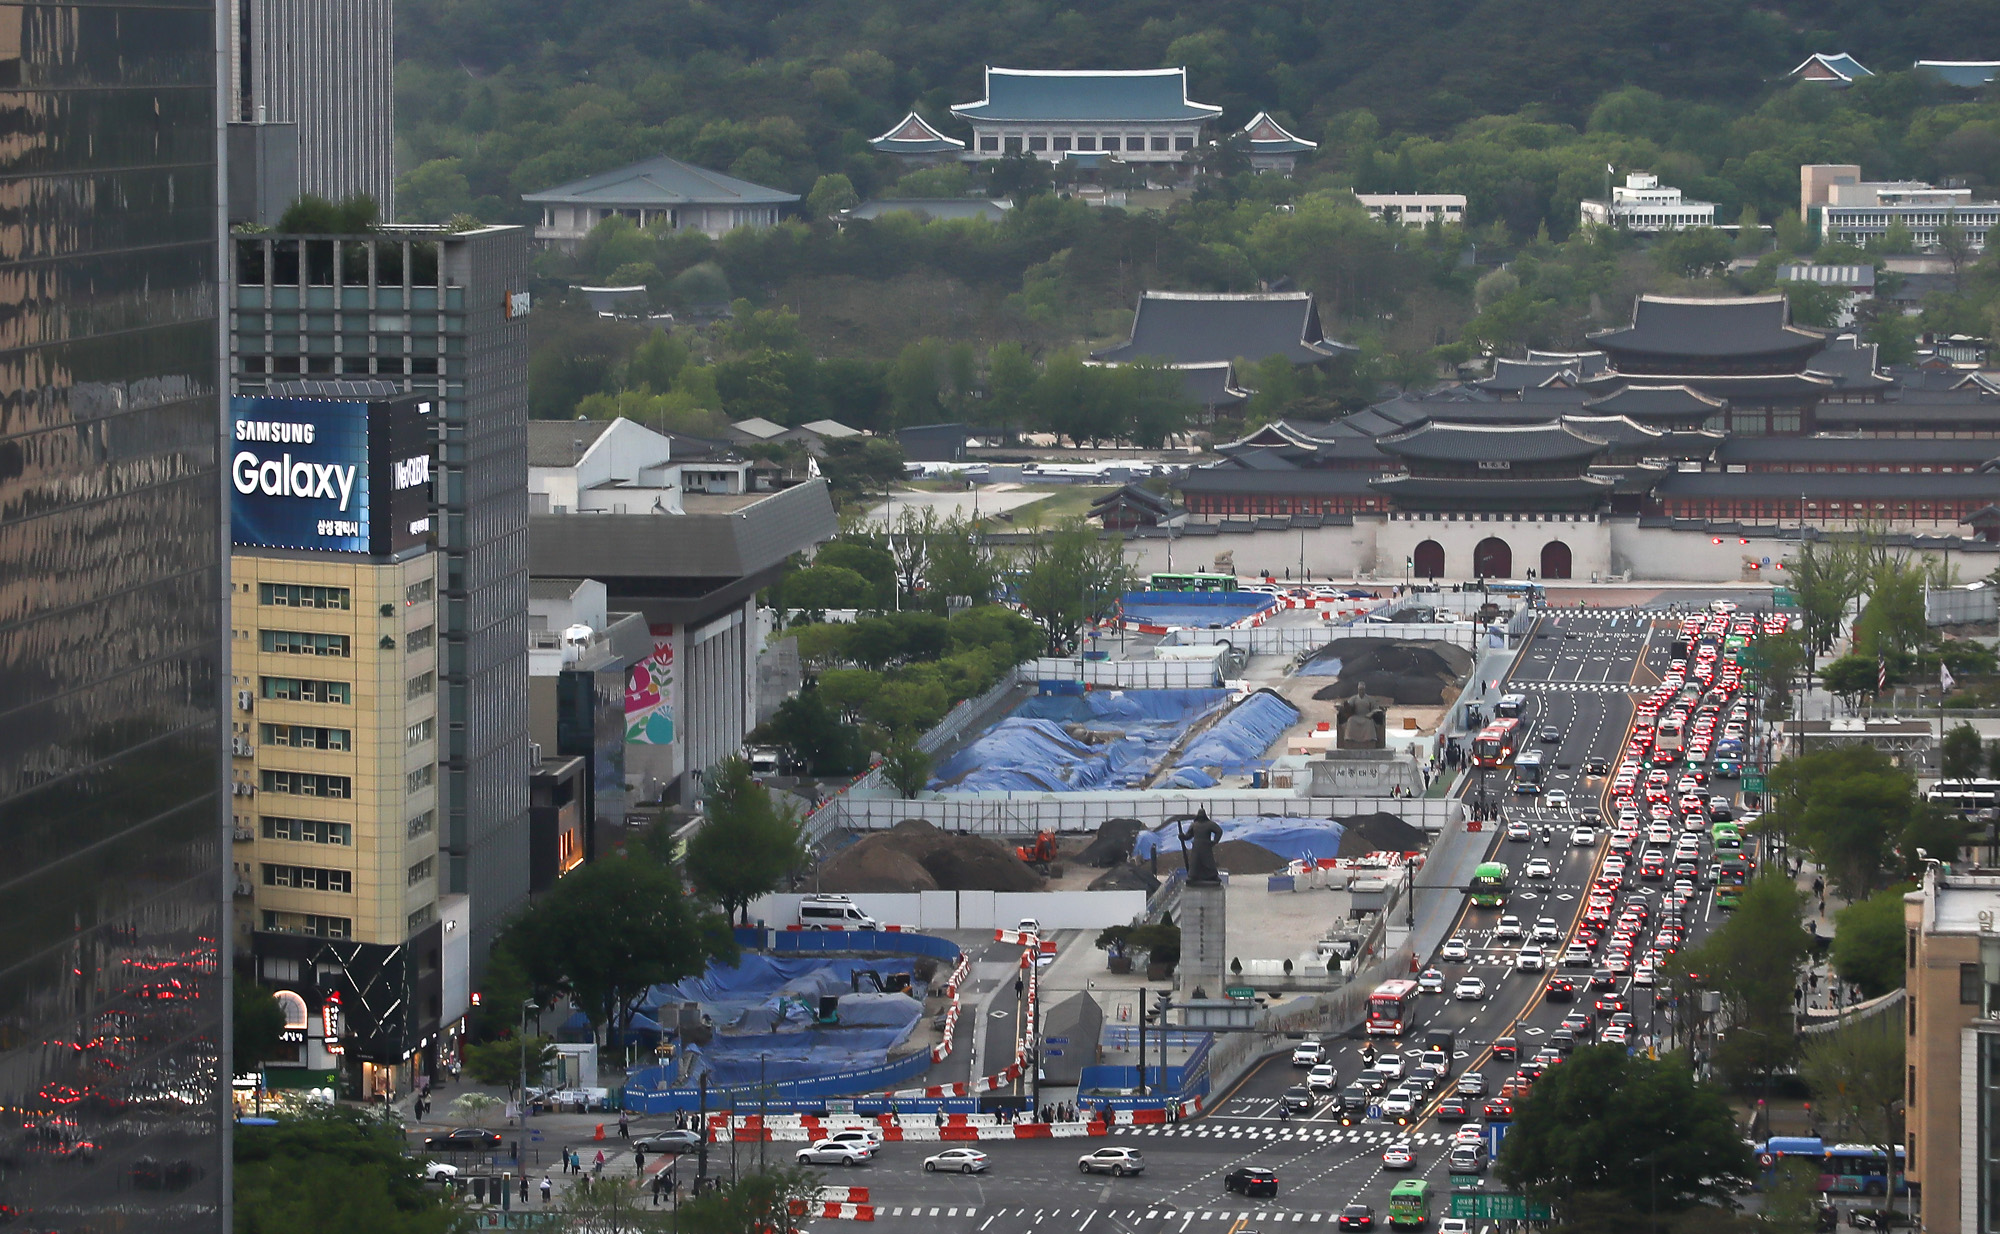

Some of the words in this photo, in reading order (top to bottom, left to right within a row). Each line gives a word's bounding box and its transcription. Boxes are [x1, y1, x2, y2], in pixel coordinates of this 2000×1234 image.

[236, 420, 315, 444] SAMSUNG
[232, 451, 358, 512] Galaxy
[317, 519, 333, 536] 삼성
